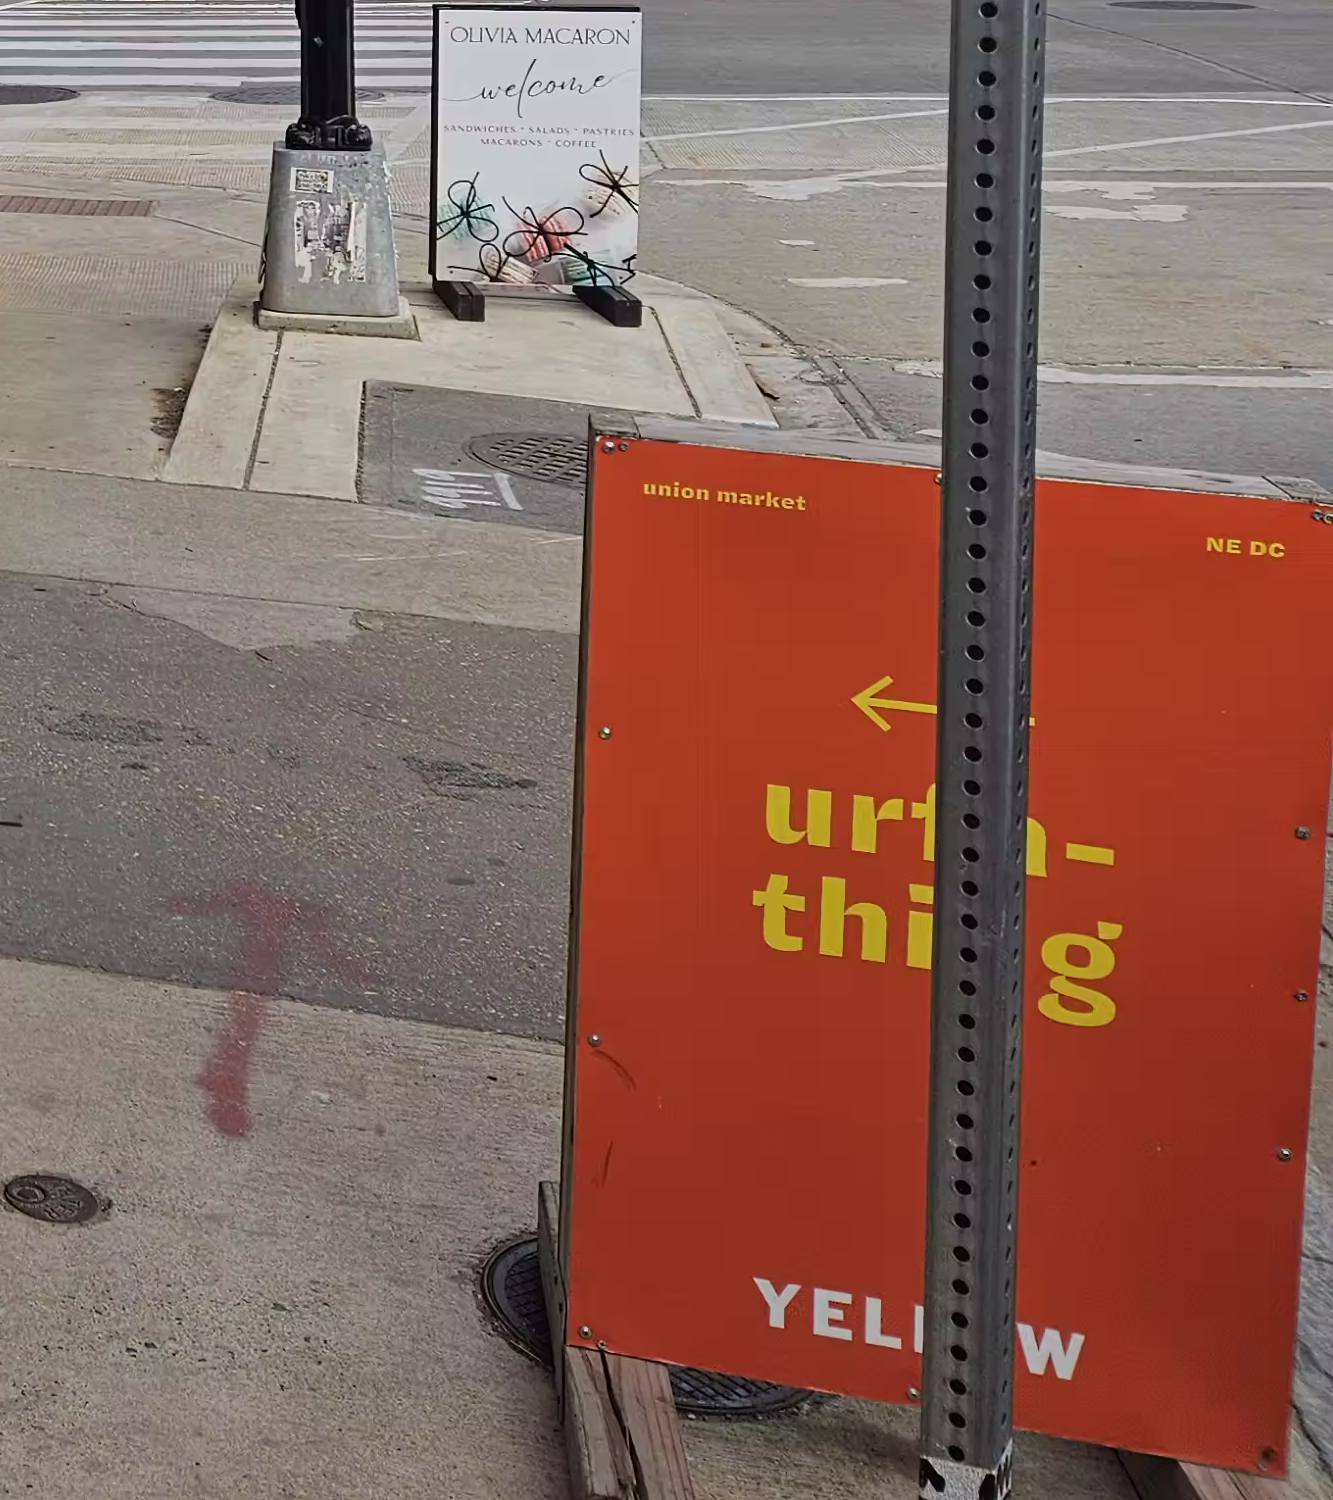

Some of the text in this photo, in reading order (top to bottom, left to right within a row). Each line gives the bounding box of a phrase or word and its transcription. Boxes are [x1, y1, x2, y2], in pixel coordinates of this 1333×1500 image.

[450, 26, 630, 45] OLIVIA MACARON
[455, 58, 617, 118] welcome
[443, 124, 635, 137] SANDWICHES SALADS PASTRIES
[480, 138, 597, 148] MACARONS COFFEE
[642, 480, 807, 512] union market
[1205, 536, 1286, 558] NE DC
[752, 873, 1123, 1027] thig
